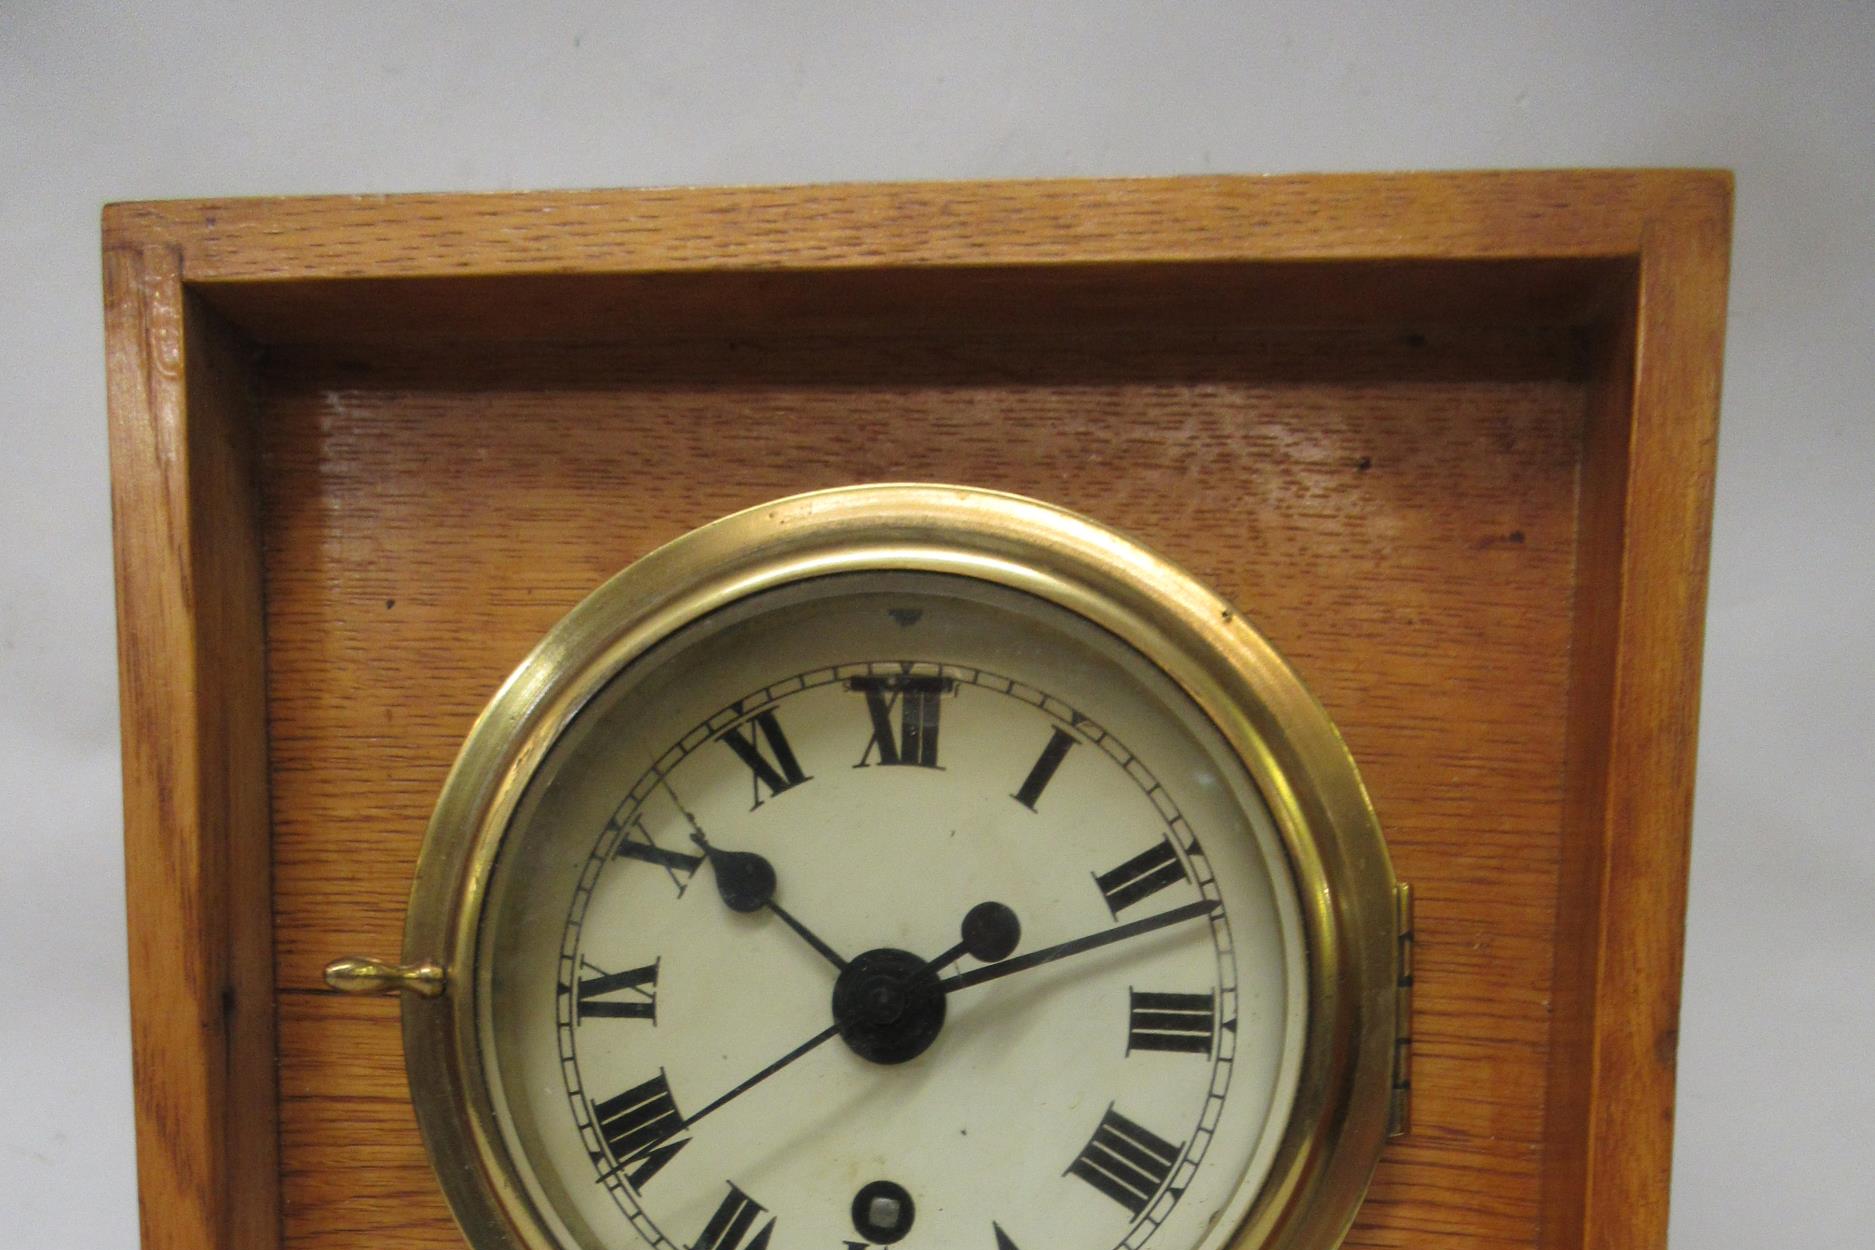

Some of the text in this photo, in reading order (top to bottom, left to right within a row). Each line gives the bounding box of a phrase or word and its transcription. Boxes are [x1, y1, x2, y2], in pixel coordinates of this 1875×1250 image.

[714, 704, 814, 812] XI
[851, 674, 946, 771] XII
[1009, 725, 1081, 814] I
[611, 812, 707, 899] X
[1091, 834, 1193, 921] II
[576, 954, 661, 1027] IX
[1126, 985, 1215, 1058] III
[590, 1065, 693, 1197] VIII
